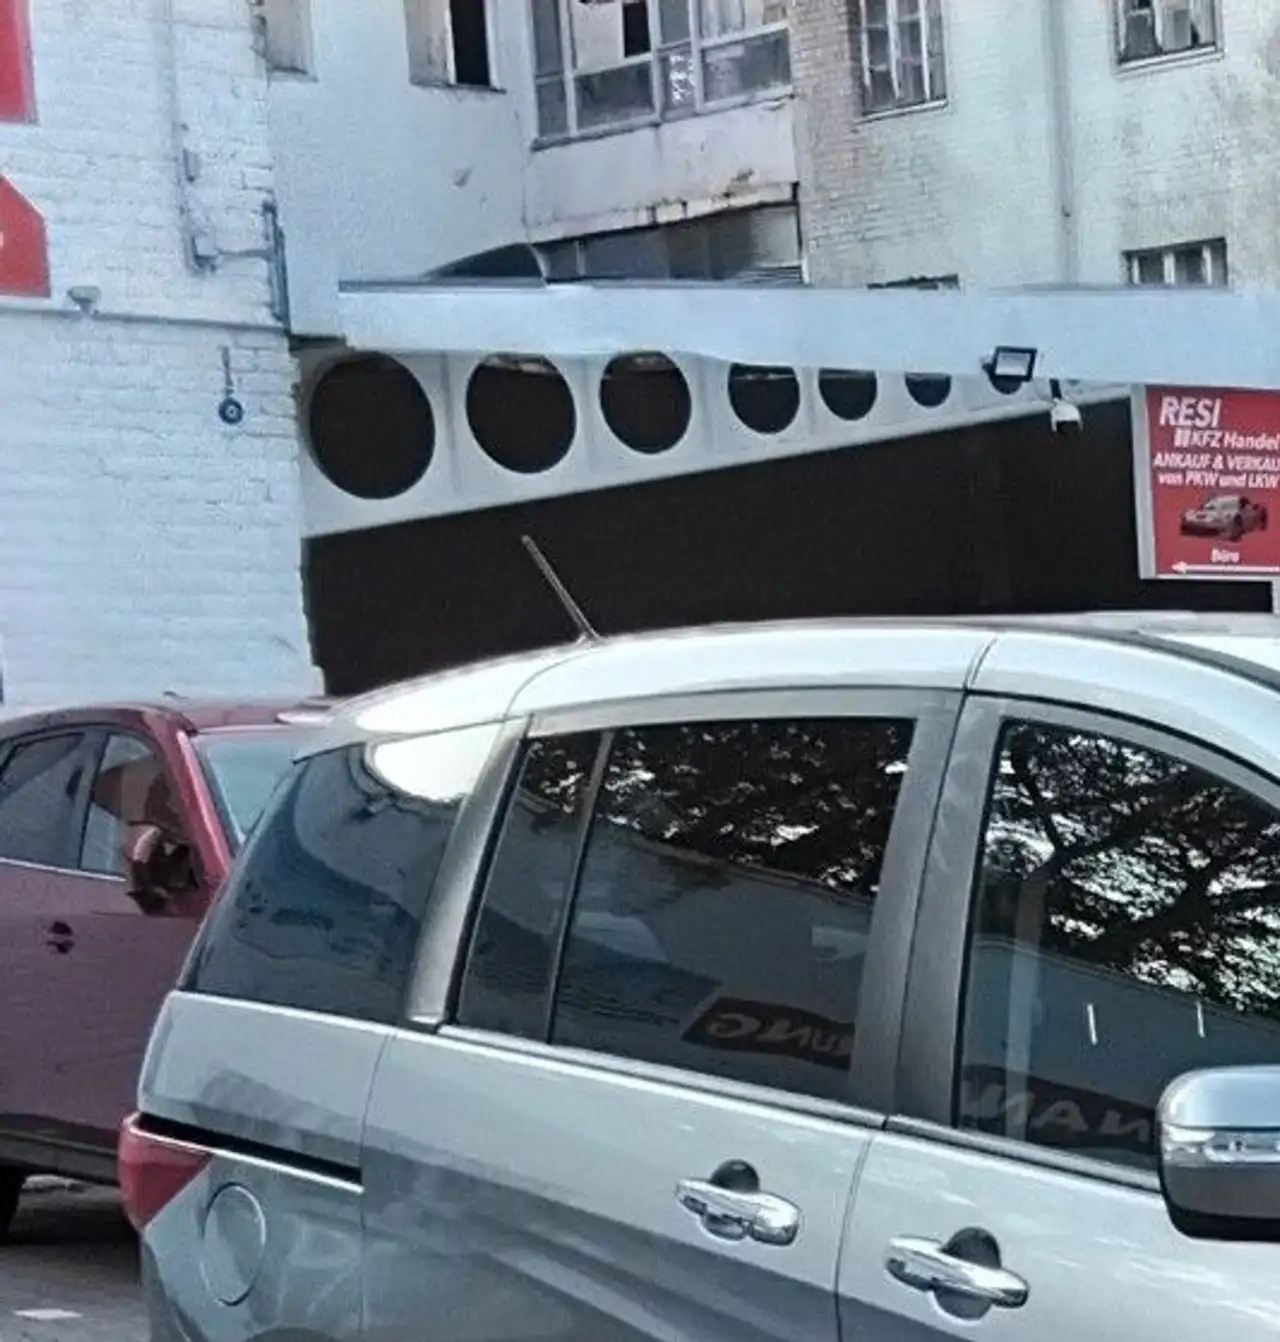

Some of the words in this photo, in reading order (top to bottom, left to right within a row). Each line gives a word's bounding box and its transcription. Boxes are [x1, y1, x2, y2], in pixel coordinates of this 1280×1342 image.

[1160, 396, 1222, 428] RESI
[1190, 429, 1221, 449] KFZ
[1223, 432, 1280, 451] Handel
[1153, 452, 1212, 470] ANKAUF
[1212, 454, 1225, 471] &
[1158, 473, 1184, 486] von
[1185, 471, 1219, 487] PKW
[1219, 473, 1246, 488] und
[1248, 473, 1280, 489] LKW
